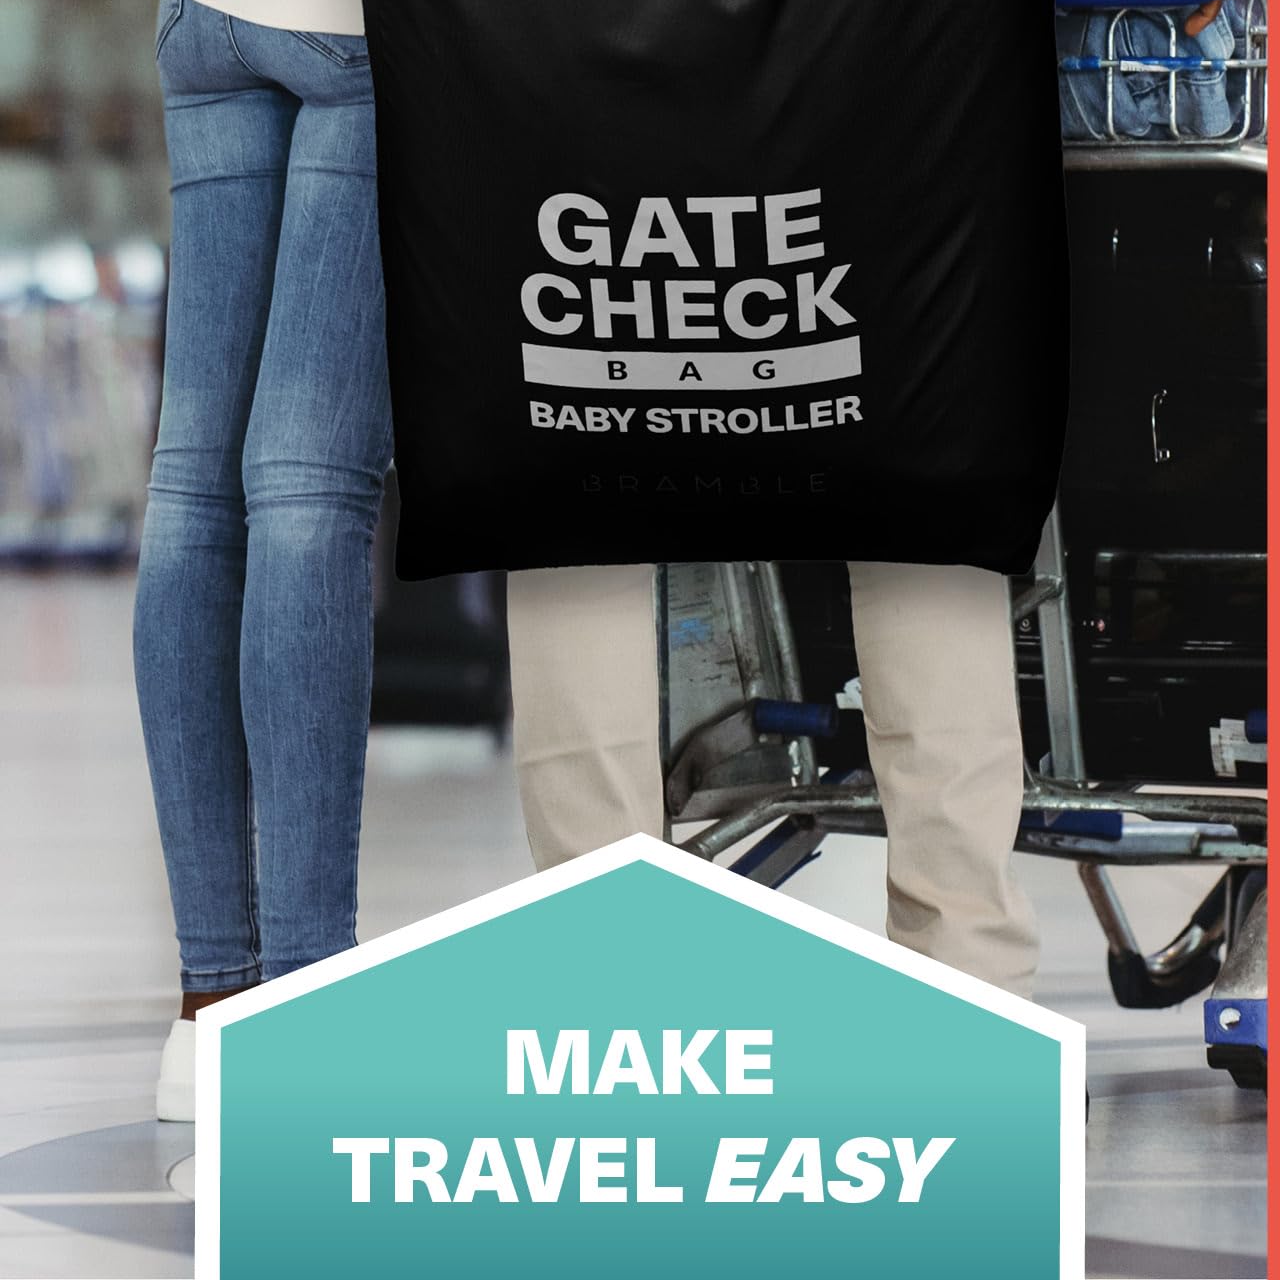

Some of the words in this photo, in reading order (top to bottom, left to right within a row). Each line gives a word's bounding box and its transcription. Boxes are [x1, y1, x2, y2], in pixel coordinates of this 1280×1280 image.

[537, 187, 825, 268] GATE
[520, 263, 857, 340] CHECK
[607, 359, 776, 382] BAG
[529, 400, 637, 433] BABY
[645, 395, 864, 434] STROLLER
[582, 471, 826, 495] BRAMBLE
